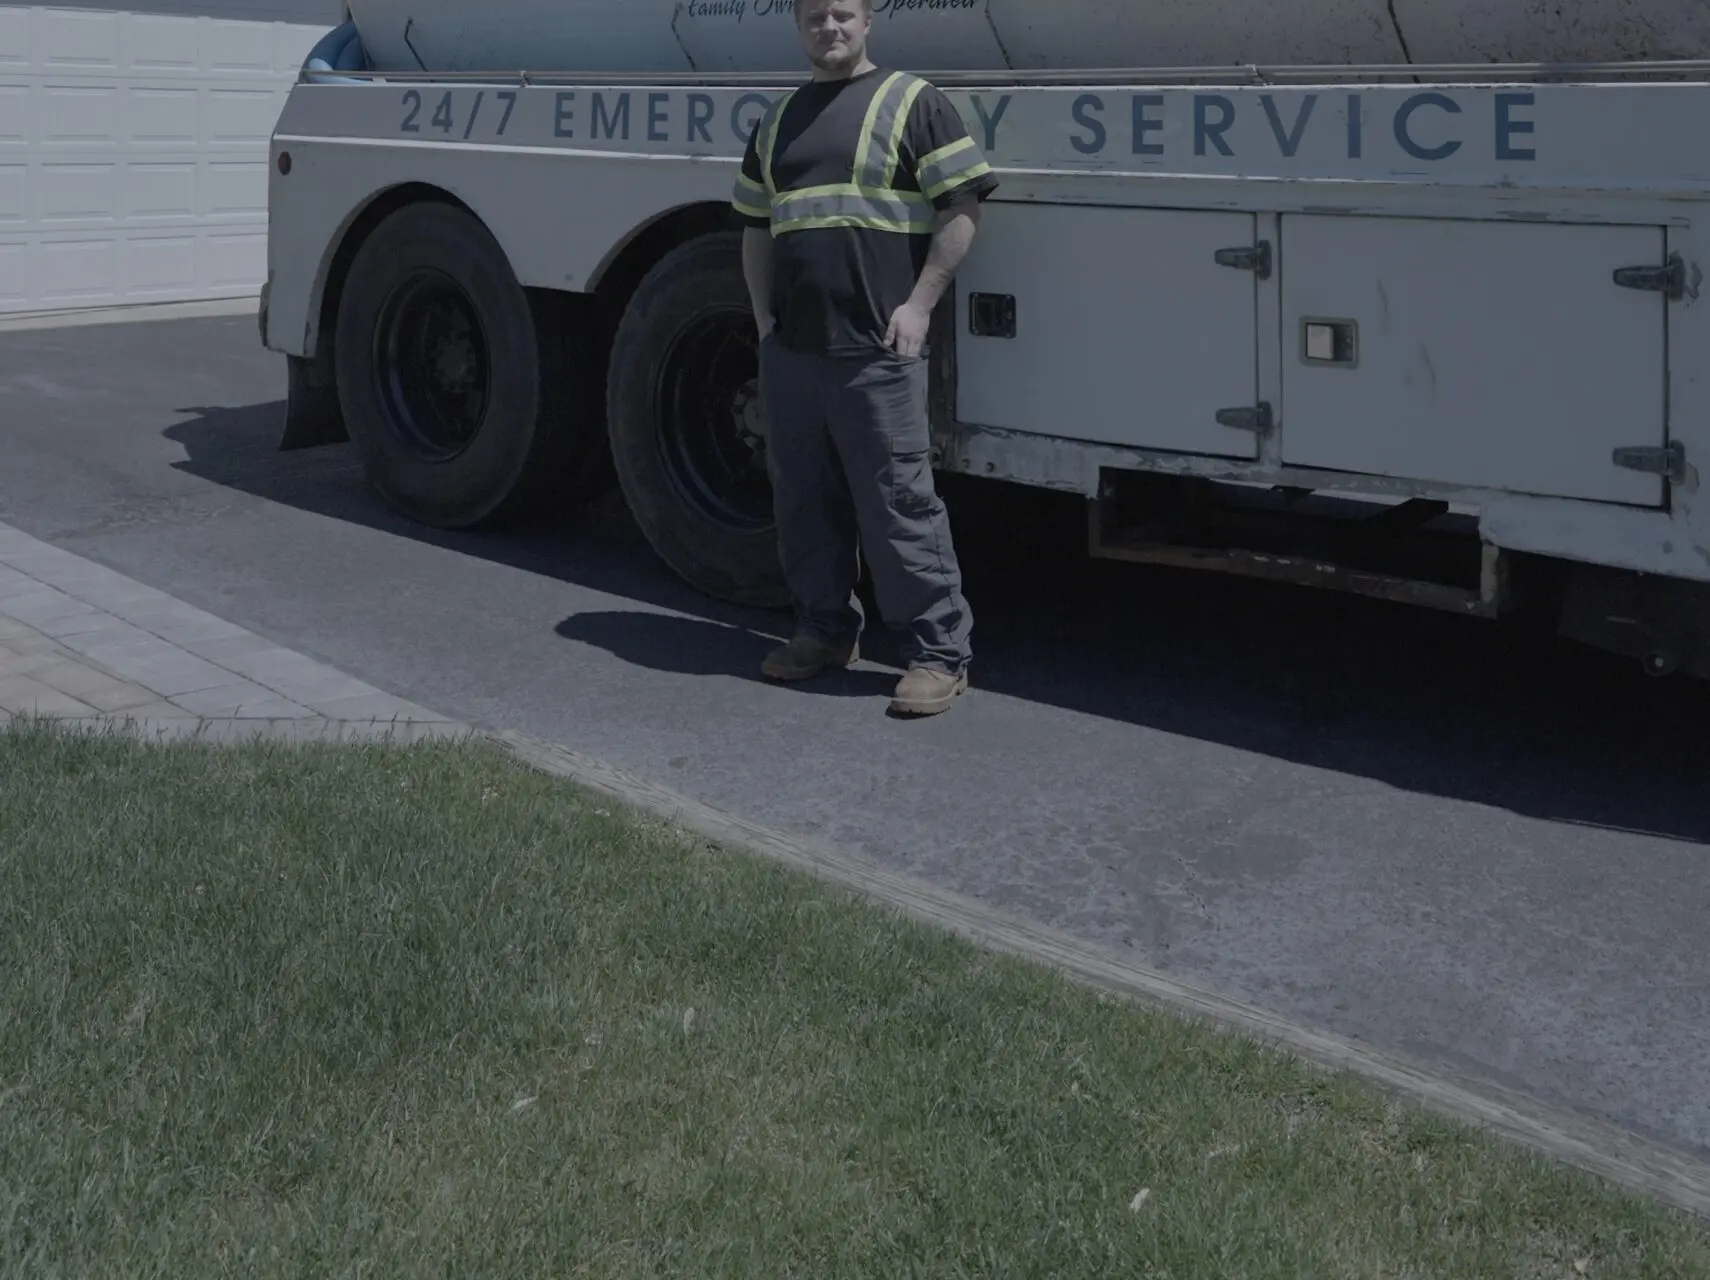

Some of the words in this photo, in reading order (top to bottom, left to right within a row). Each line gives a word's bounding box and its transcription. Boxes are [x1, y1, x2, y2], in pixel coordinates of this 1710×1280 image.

[401, 89, 517, 140] 24/7
[554, 92, 1012, 151] EMERGY
[1069, 92, 1537, 161] SERVICE
